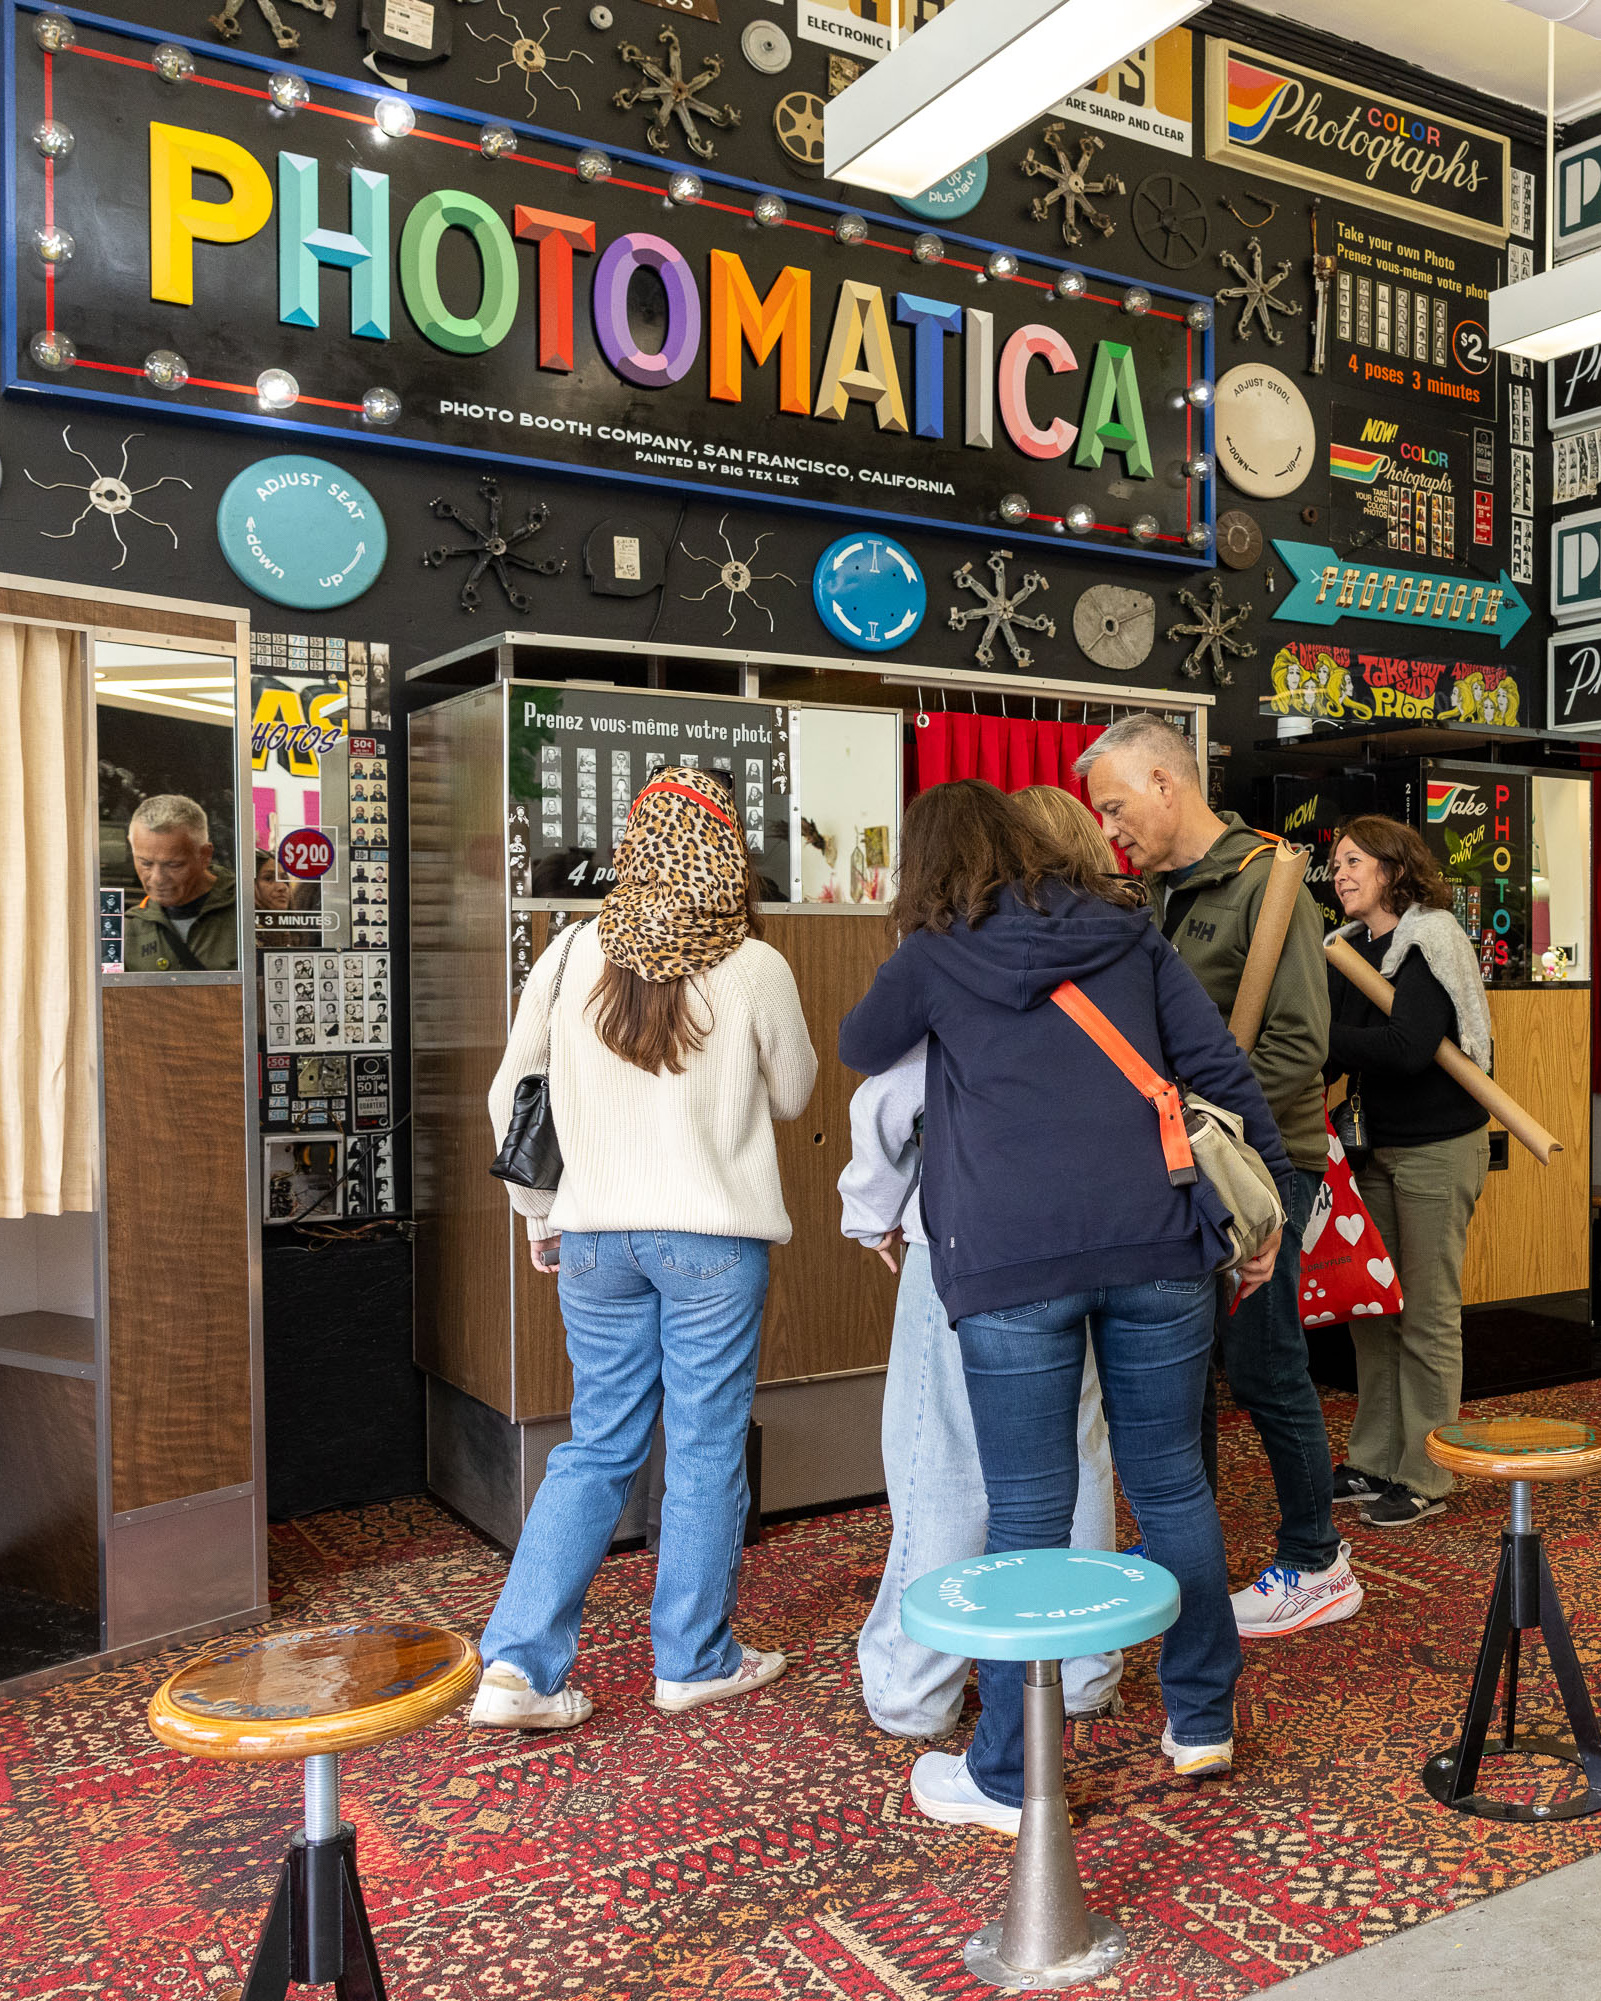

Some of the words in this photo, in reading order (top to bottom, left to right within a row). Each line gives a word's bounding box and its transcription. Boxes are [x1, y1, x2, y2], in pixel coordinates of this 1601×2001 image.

[806, 15, 884, 49] ELECTRONIC
[1065, 97, 1087, 112] ARE
[1089, 104, 1126, 123] SHARP
[1128, 117, 1150, 131] AND
[1152, 124, 1185, 142] CLEAR
[1368, 106, 1441, 147] COLOR
[1260, 79, 1488, 194] Photographs
[928, 191, 955, 203] plus
[953, 169, 977, 198] haut
[946, 171, 962, 187] up
[1337, 221, 1364, 244] Take
[1368, 234, 1393, 252] your
[1397, 245, 1420, 261] own
[1425, 249, 1455, 272] Photo
[1337, 243, 1373, 267] Prenez
[1376, 258, 1433, 285] vous-même
[1437, 276, 1462, 293] votre
[1465, 283, 1490, 301] phot
[150, 120, 1154, 479] PHOTOMATICA
[1233, 377, 1264, 397] ADJUST
[1267, 381, 1291, 404] STOOL
[1348, 353, 1359, 373] 4
[1365, 362, 1404, 385] poses
[1412, 370, 1421, 390] 3
[1427, 376, 1481, 403] minutes
[1360, 418, 1399, 443] NOW!
[440, 400, 515, 424] PHOTO
[519, 412, 593, 437] BOOTH
[597, 426, 698, 456] COMPANY,
[702, 443, 743, 462] SAN
[747, 450, 855, 483] FRANCISCO,
[858, 469, 956, 496] CALIFORNIA
[1229, 446, 1249, 471] DOWN
[1400, 442, 1449, 469] COLOR
[635, 451, 694, 469] PAINTED
[698, 460, 718, 473] BY
[721, 464, 744, 477] BIG
[748, 468, 773, 482] TEX
[776, 473, 800, 486] LEX
[1286, 460, 1297, 473] UP
[1371, 455, 1455, 497] Photographs
[255, 472, 323, 501] ADJUST
[327, 483, 365, 521] SEAT
[1356, 491, 1371, 501] YOUR
[1374, 496, 1388, 504] OWN
[1367, 501, 1388, 511] COLOR
[1372, 488, 1388, 497] TAKE
[1363, 507, 1388, 518] PHOTOS
[246, 533, 285, 580] down
[318, 573, 344, 588] up
[1316, 566, 1504, 626] PHOTOBOOTH
[524, 702, 583, 731] Prenez
[590, 716, 679, 738] vous-même
[686, 720, 728, 742] votre
[252, 722, 341, 754] HOTOS
[1284, 794, 1319, 833] WOW!
[1444, 782, 1489, 822] Take
[1318, 829, 1340, 842] INS
[1460, 824, 1486, 850] YOUR
[1450, 846, 1473, 865] OWN
[567, 860, 588, 886] 4
[265, 915, 274, 926] 3
[278, 915, 332, 926] MINUTES
[1187, 919, 1217, 943] HH
[357, 1082, 373, 1092] 50
[962, 1557, 1028, 1577] SEAT
[939, 1577, 988, 1613] ADJUST
[1329, 1570, 1355, 1596] PARIS
[1046, 1597, 1130, 1618] down
